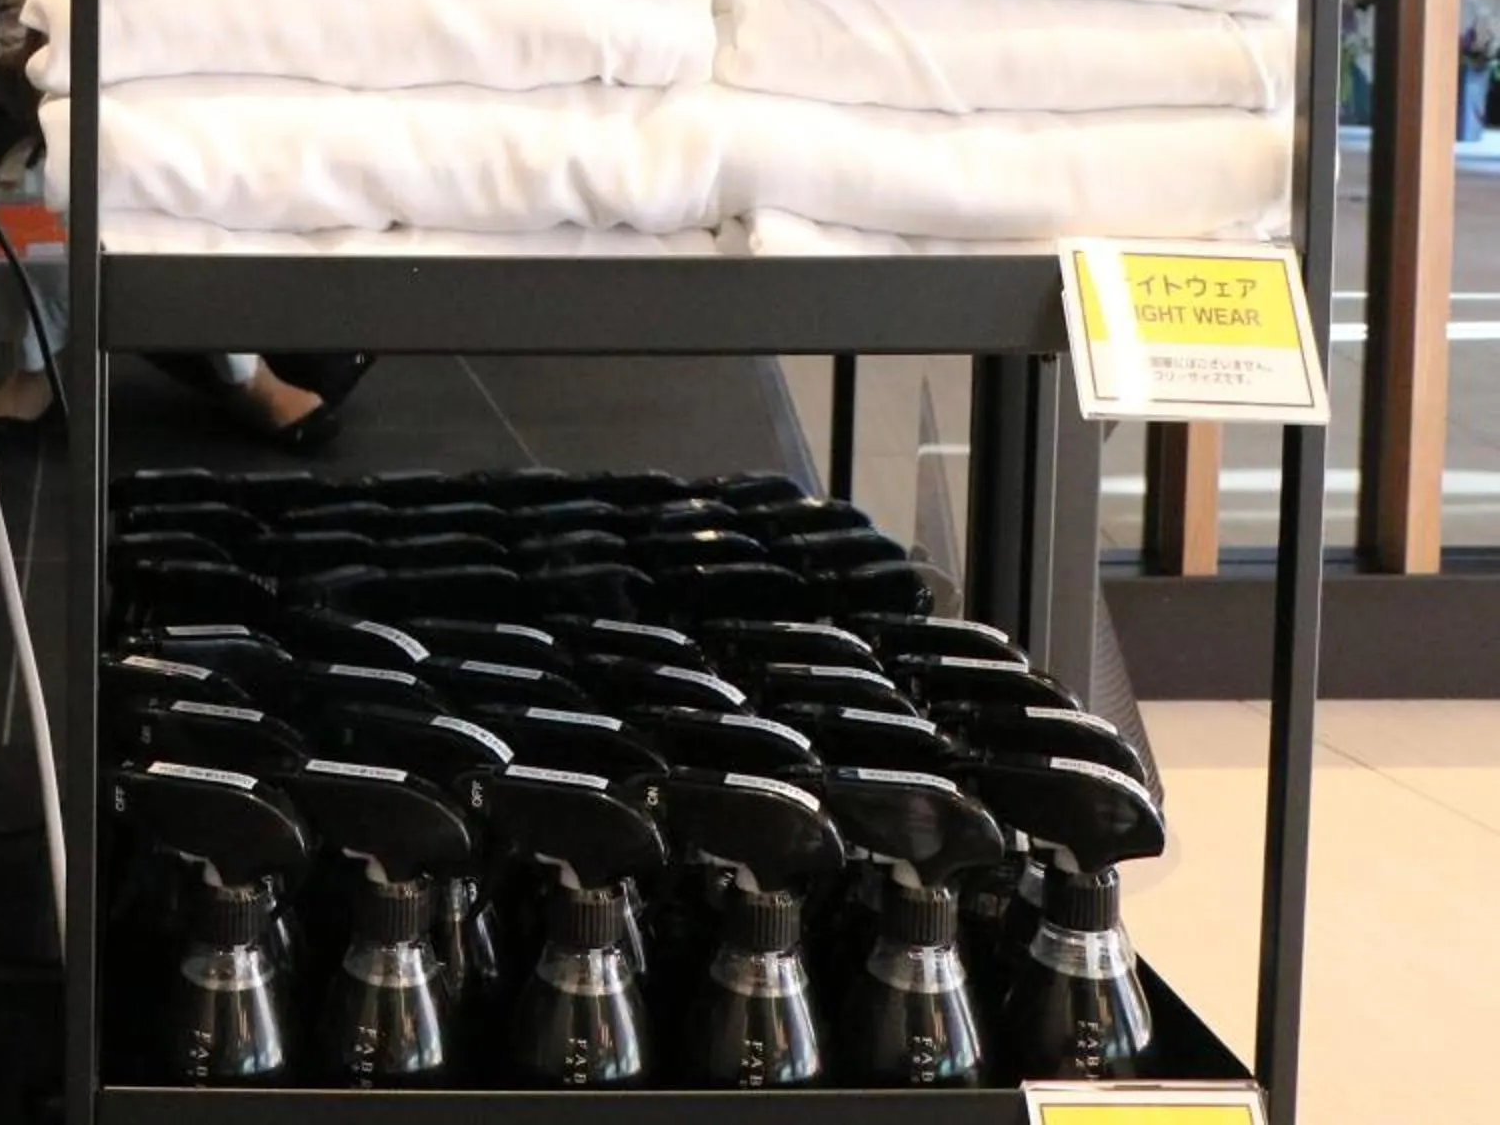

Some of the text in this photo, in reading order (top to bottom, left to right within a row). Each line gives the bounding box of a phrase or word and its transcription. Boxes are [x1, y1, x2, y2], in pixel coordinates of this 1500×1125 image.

[1126, 275, 1258, 299] イトウェア
[1133, 304, 1263, 327] IGHT WEAR
